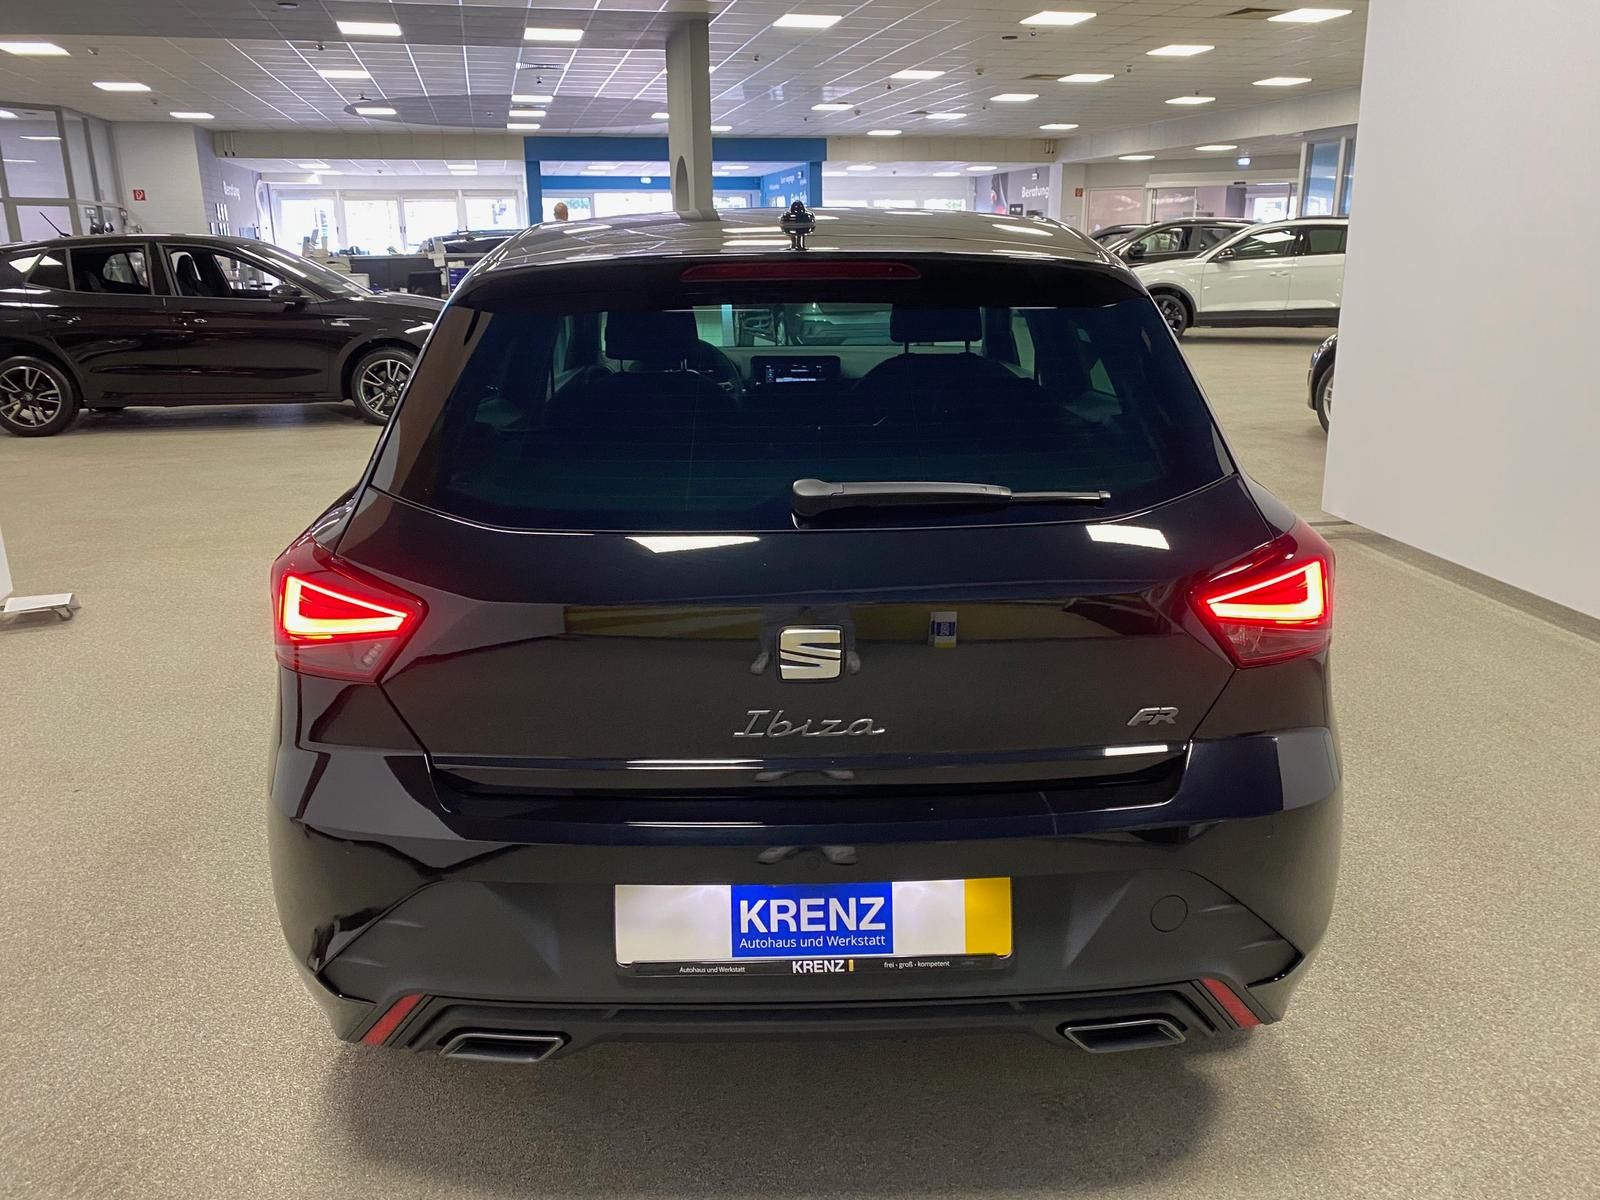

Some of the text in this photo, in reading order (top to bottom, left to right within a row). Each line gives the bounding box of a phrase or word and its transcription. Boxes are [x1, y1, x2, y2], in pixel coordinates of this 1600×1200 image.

[1021, 185, 1050, 199] Beratung
[733, 709, 886, 738] Ibiza
[1127, 706, 1180, 727] FR
[740, 897, 886, 933] KRENZ
[739, 934, 886, 949] Autohaus und Werkstatt
[792, 959, 845, 974] KRENZ
[917, 960, 950, 968] kompetent
